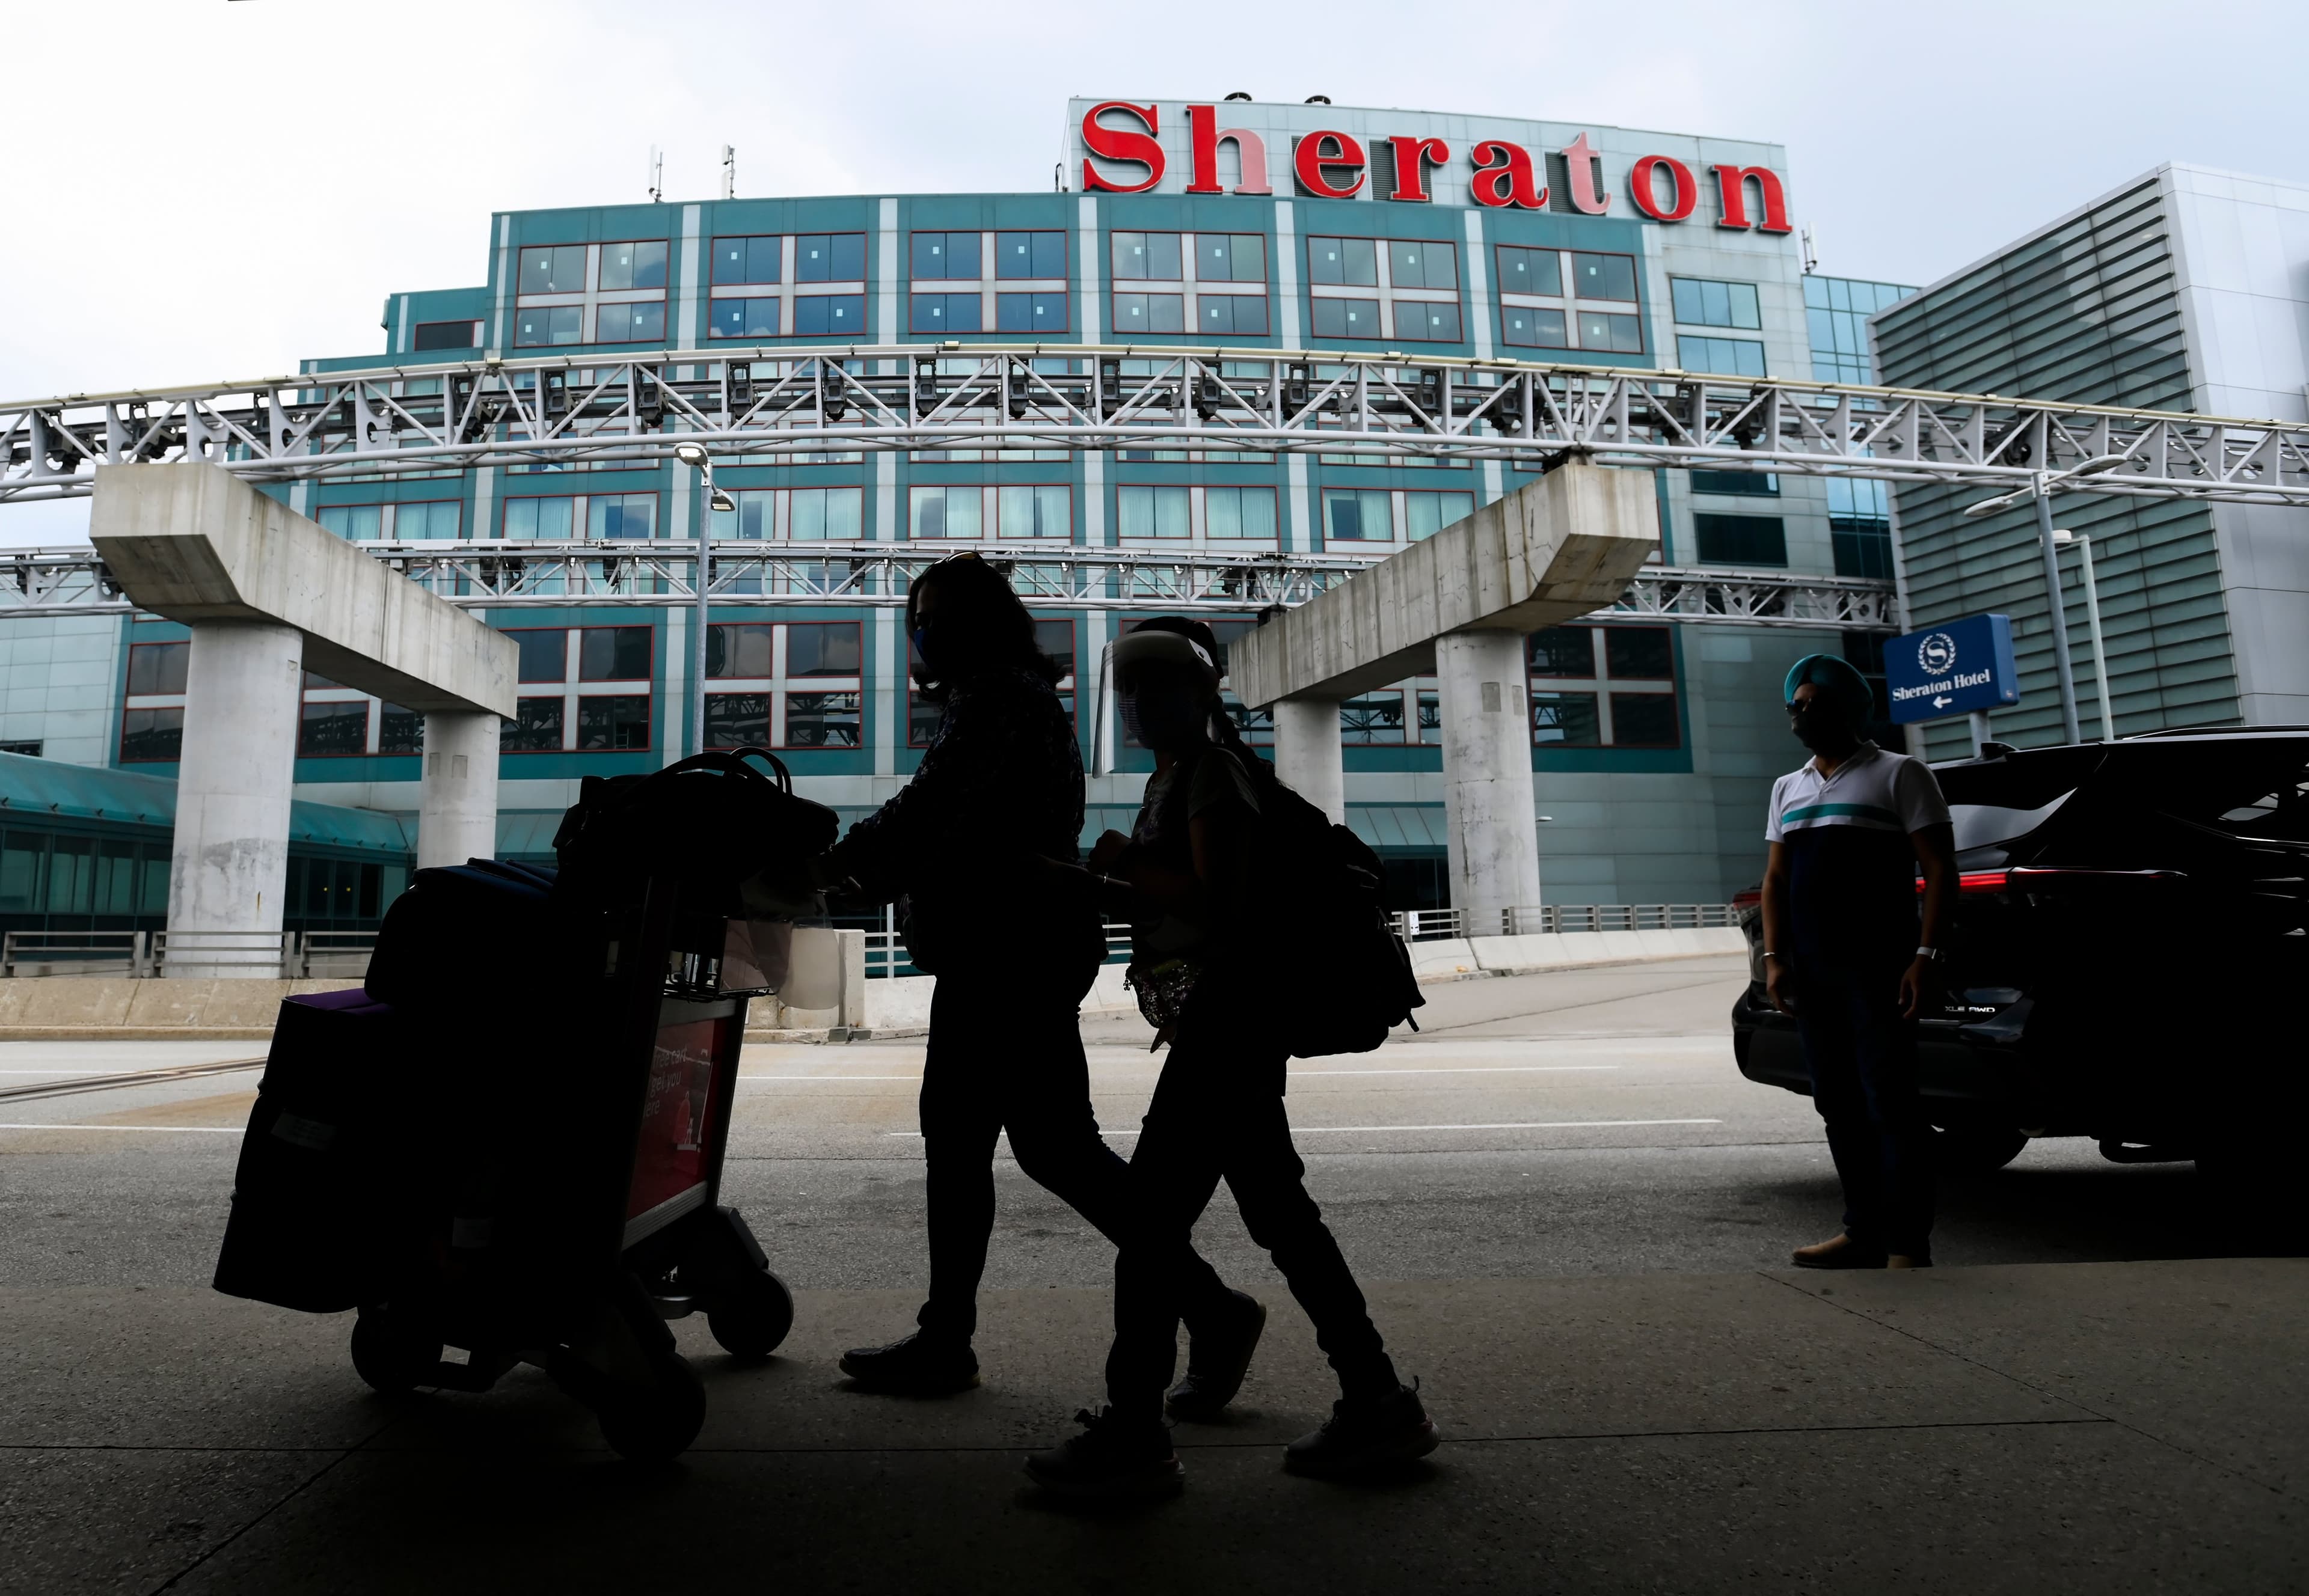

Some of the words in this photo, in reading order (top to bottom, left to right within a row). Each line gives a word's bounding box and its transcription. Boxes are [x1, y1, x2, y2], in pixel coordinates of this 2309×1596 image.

[1081, 100, 1792, 234] Sheraton
[1892, 679, 1952, 702] Sheraton
[1954, 668, 1991, 689] Hotel
[649, 1071, 665, 1099] get
[665, 1071, 682, 1094] you
